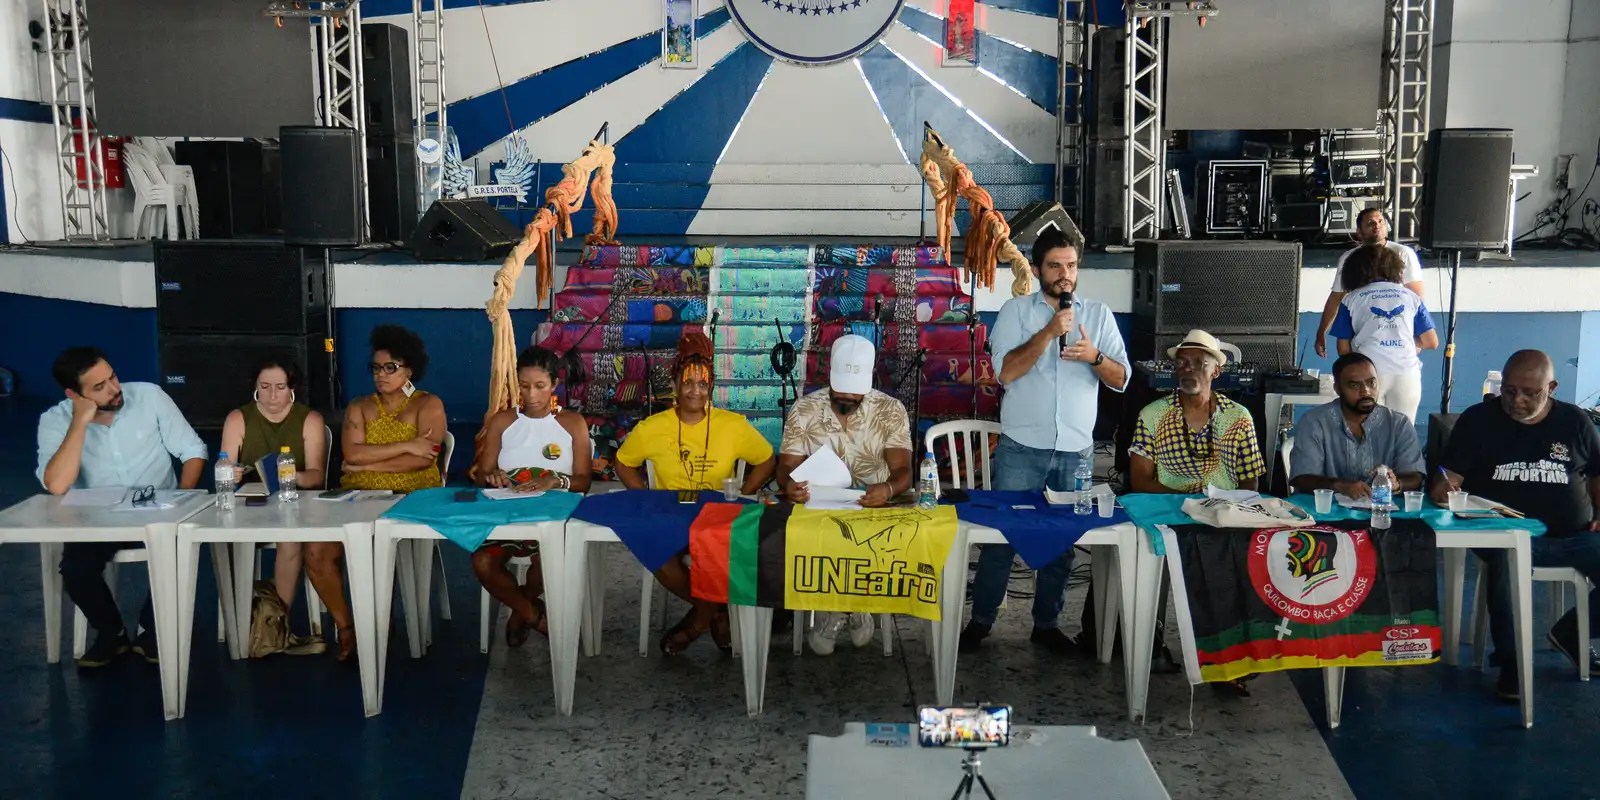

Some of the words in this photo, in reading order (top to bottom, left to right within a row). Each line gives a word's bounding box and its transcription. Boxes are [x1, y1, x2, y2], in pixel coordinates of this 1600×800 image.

[497, 186, 518, 194] PORTELA
[1492, 468, 1569, 484] IMPORTAM
[794, 555, 937, 603] UNEafro
[1264, 584, 1310, 618] QUILOMBO
[1313, 608, 1338, 619] RAÇA
[1337, 604, 1346, 612] E
[1345, 576, 1368, 607] CLASSE
[1386, 629, 1419, 639] CSP
